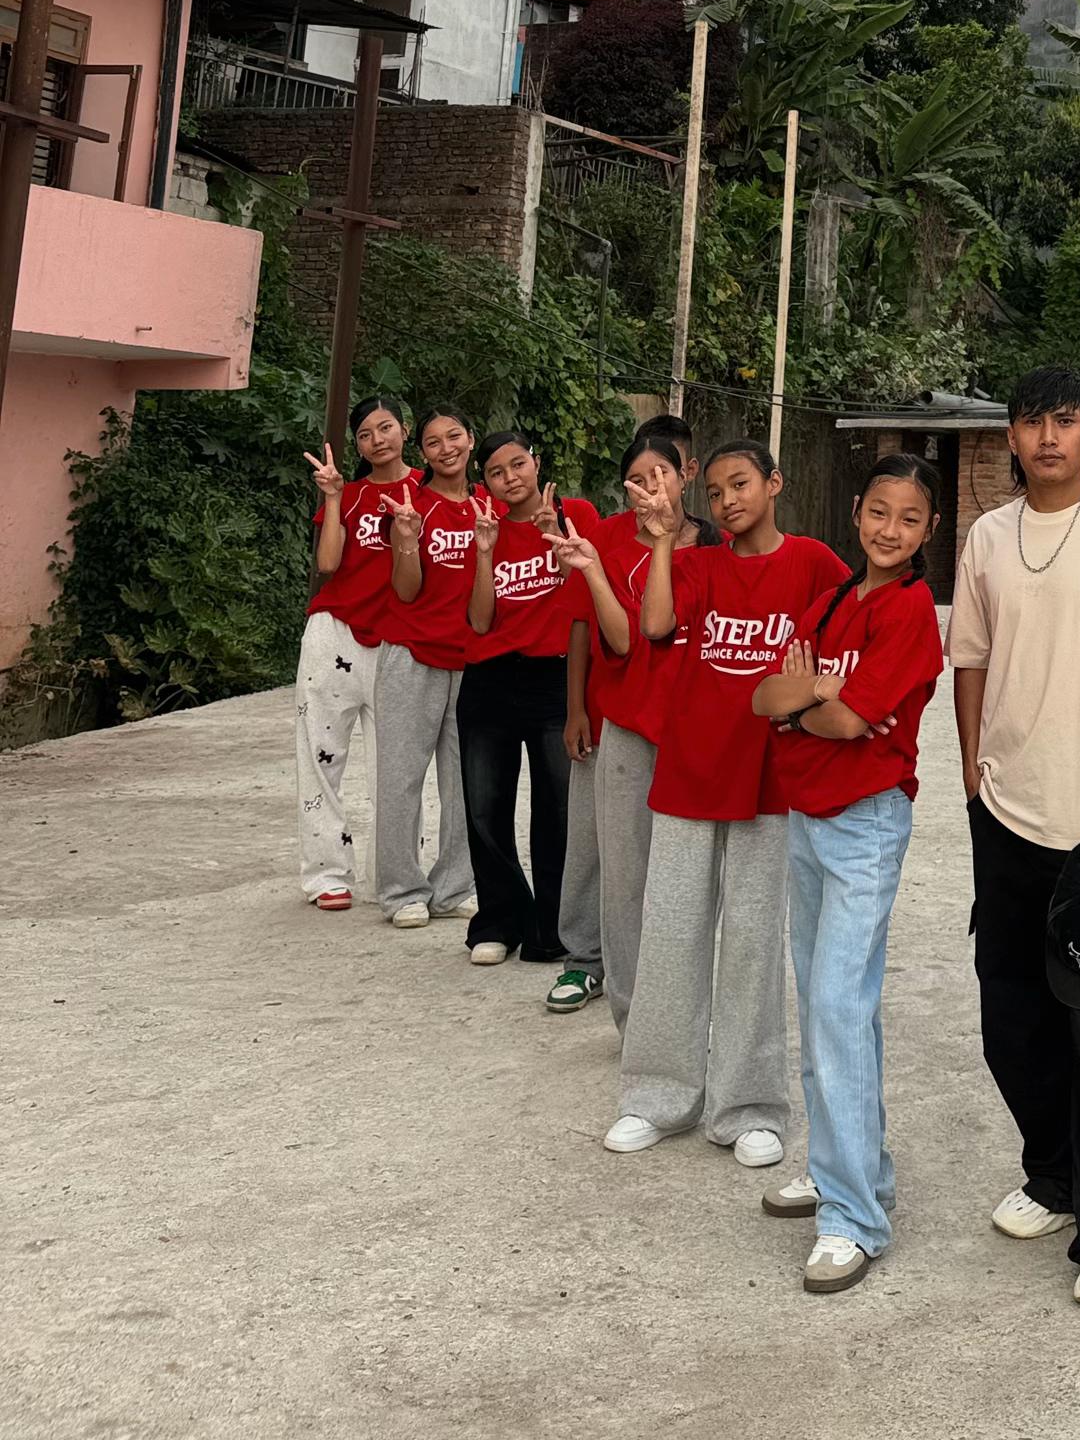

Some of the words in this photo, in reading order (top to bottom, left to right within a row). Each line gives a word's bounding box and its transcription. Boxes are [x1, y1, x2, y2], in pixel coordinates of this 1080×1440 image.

[356, 514, 382, 540] ST
[428, 528, 474, 555] STEP
[433, 553, 458, 563] DANCE
[494, 556, 544, 590] STEP
[546, 549, 560, 573] U
[496, 582, 526, 598] DANCE
[701, 610, 763, 649] STEP
[701, 648, 733, 660] DANCE
